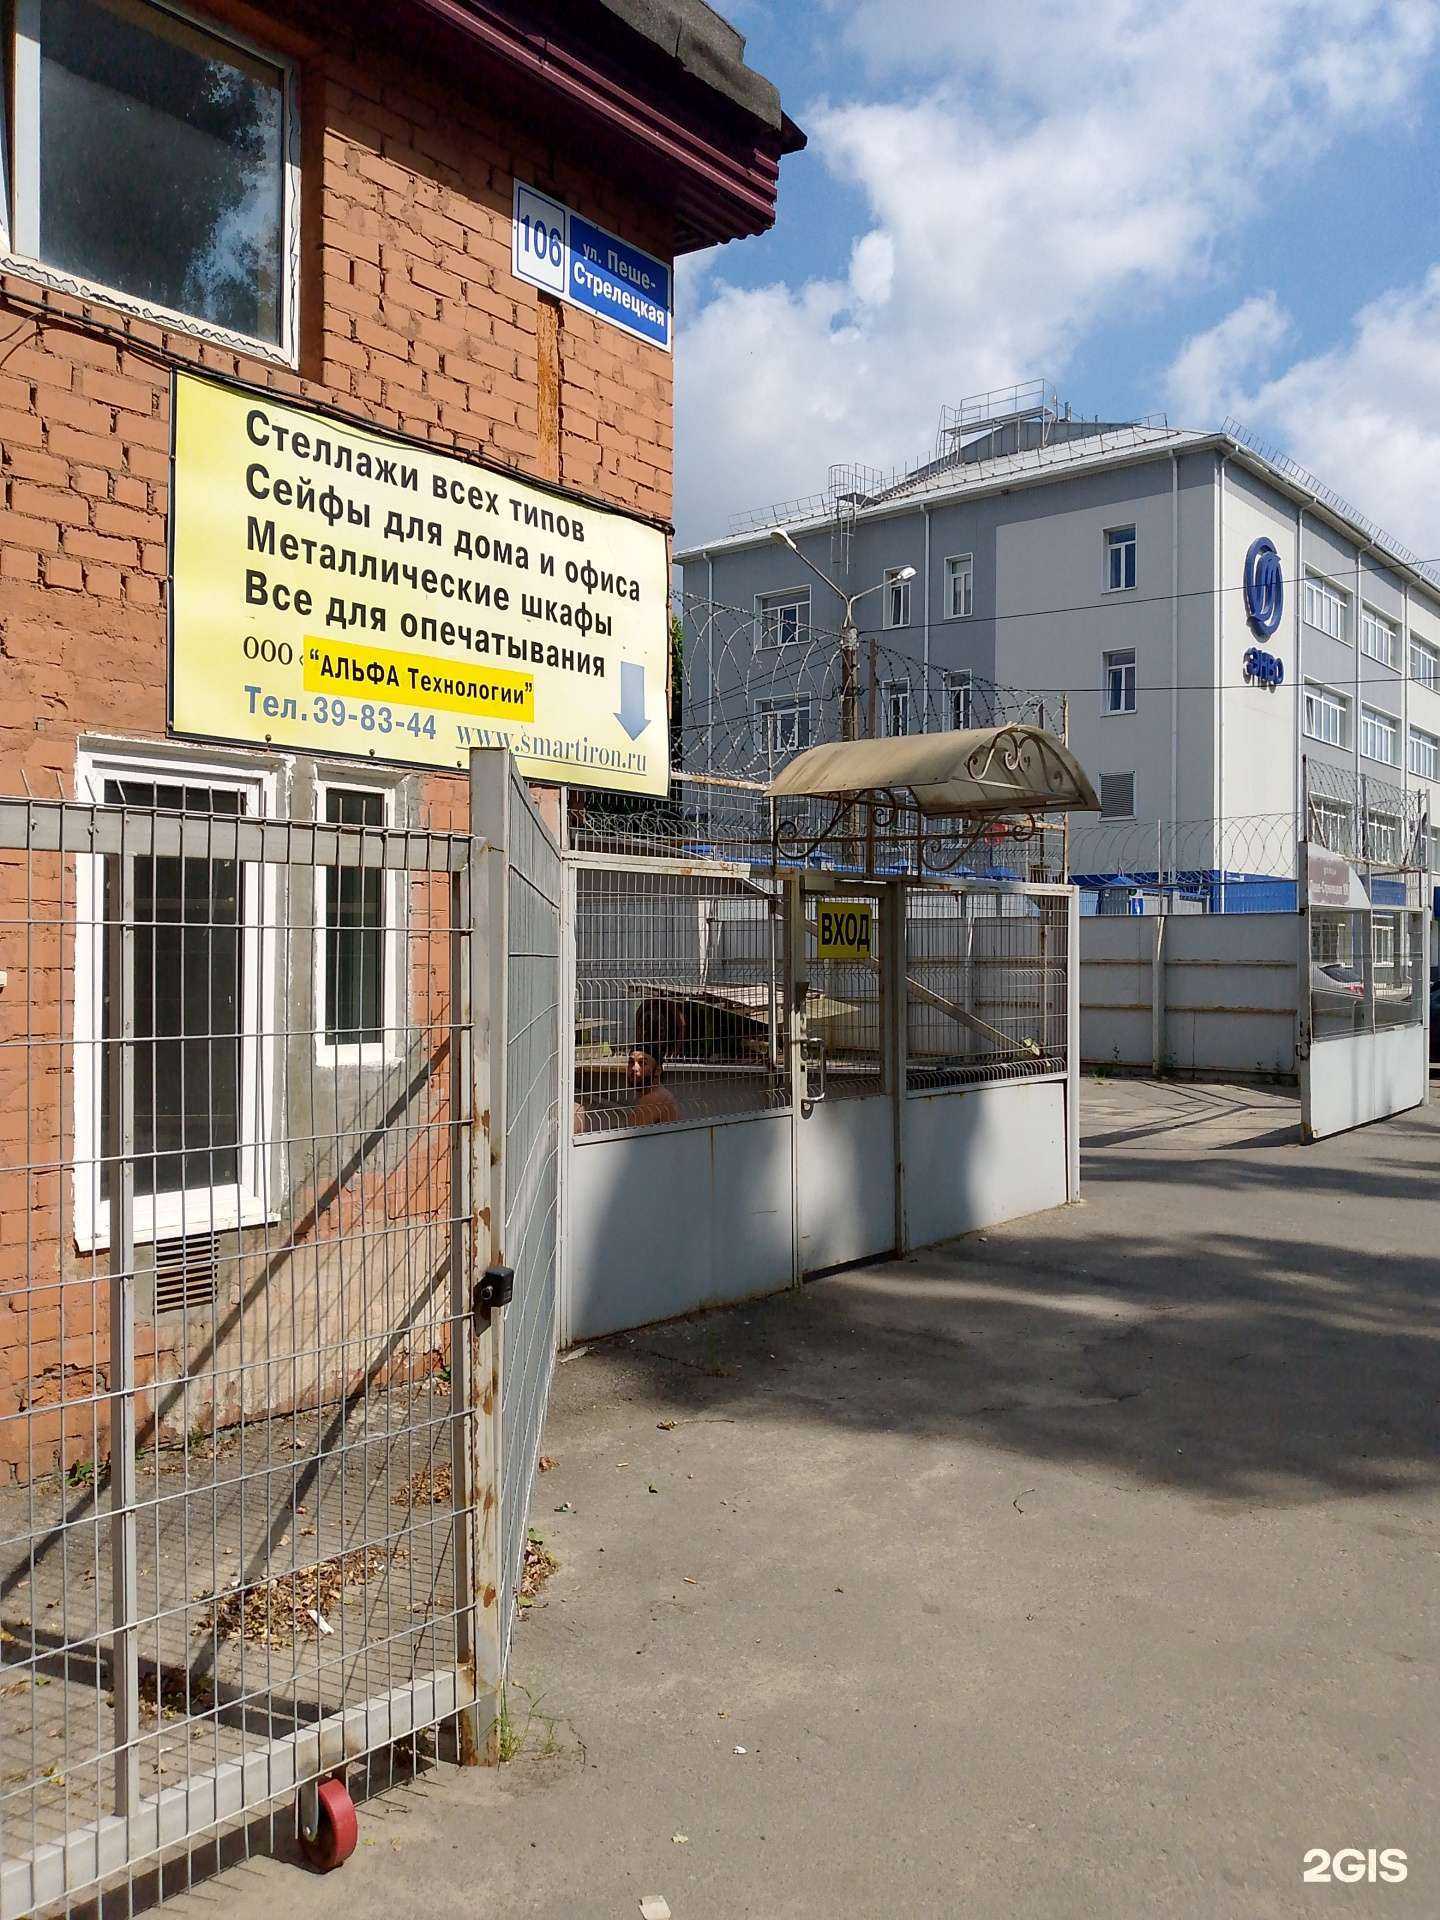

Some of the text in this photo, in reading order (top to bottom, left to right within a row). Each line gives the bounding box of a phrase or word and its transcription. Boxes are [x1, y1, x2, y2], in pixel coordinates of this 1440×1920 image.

[521, 214, 562, 268] 106
[582, 243, 656, 289] ул. Пеше-
[573, 261, 665, 327] Стрелецкая
[246, 409, 585, 542] Стеллажи всех типов
[245, 463, 640, 602] Сейфы для дома и офиса
[247, 515, 612, 637] Металлические шкафы
[245, 568, 606, 678] Все для опечатывания
[456, 725, 648, 774] www.smartiron.ru
[821, 912, 870, 953] ВХОД
